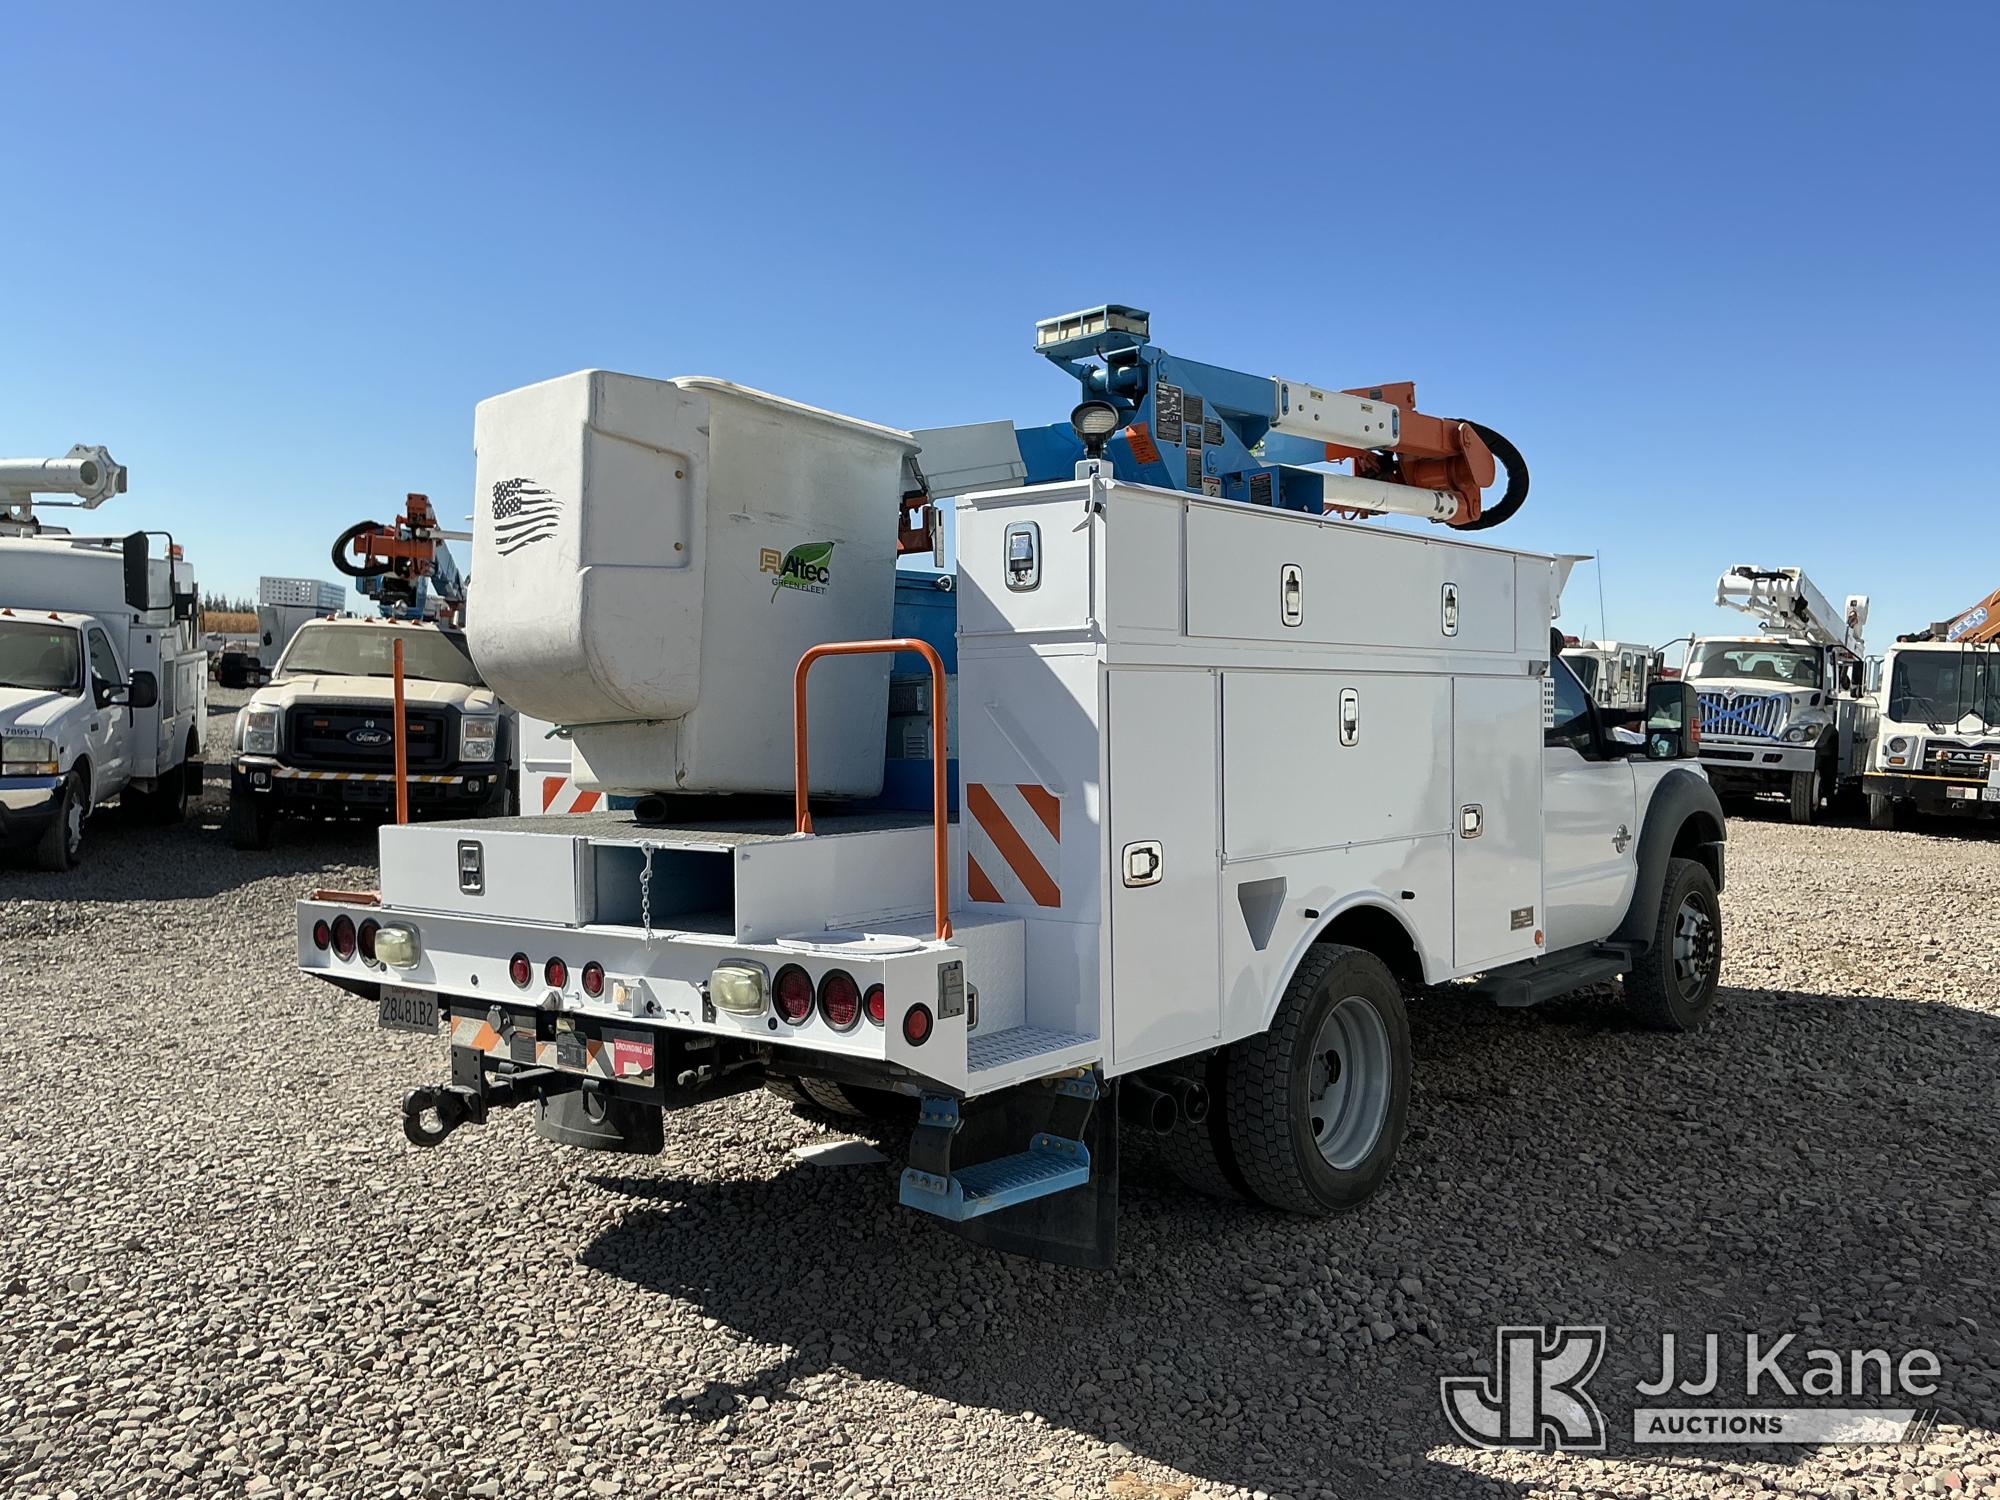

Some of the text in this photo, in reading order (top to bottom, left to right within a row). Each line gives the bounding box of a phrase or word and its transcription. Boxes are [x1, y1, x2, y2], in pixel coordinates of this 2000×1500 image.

[779, 555, 830, 584] Altec
[771, 577, 826, 595] GREEN FLEET
[356, 731, 381, 743] Ford
[382, 996, 434, 1027] 28481B2
[615, 1041, 643, 1054] GROUNDING
